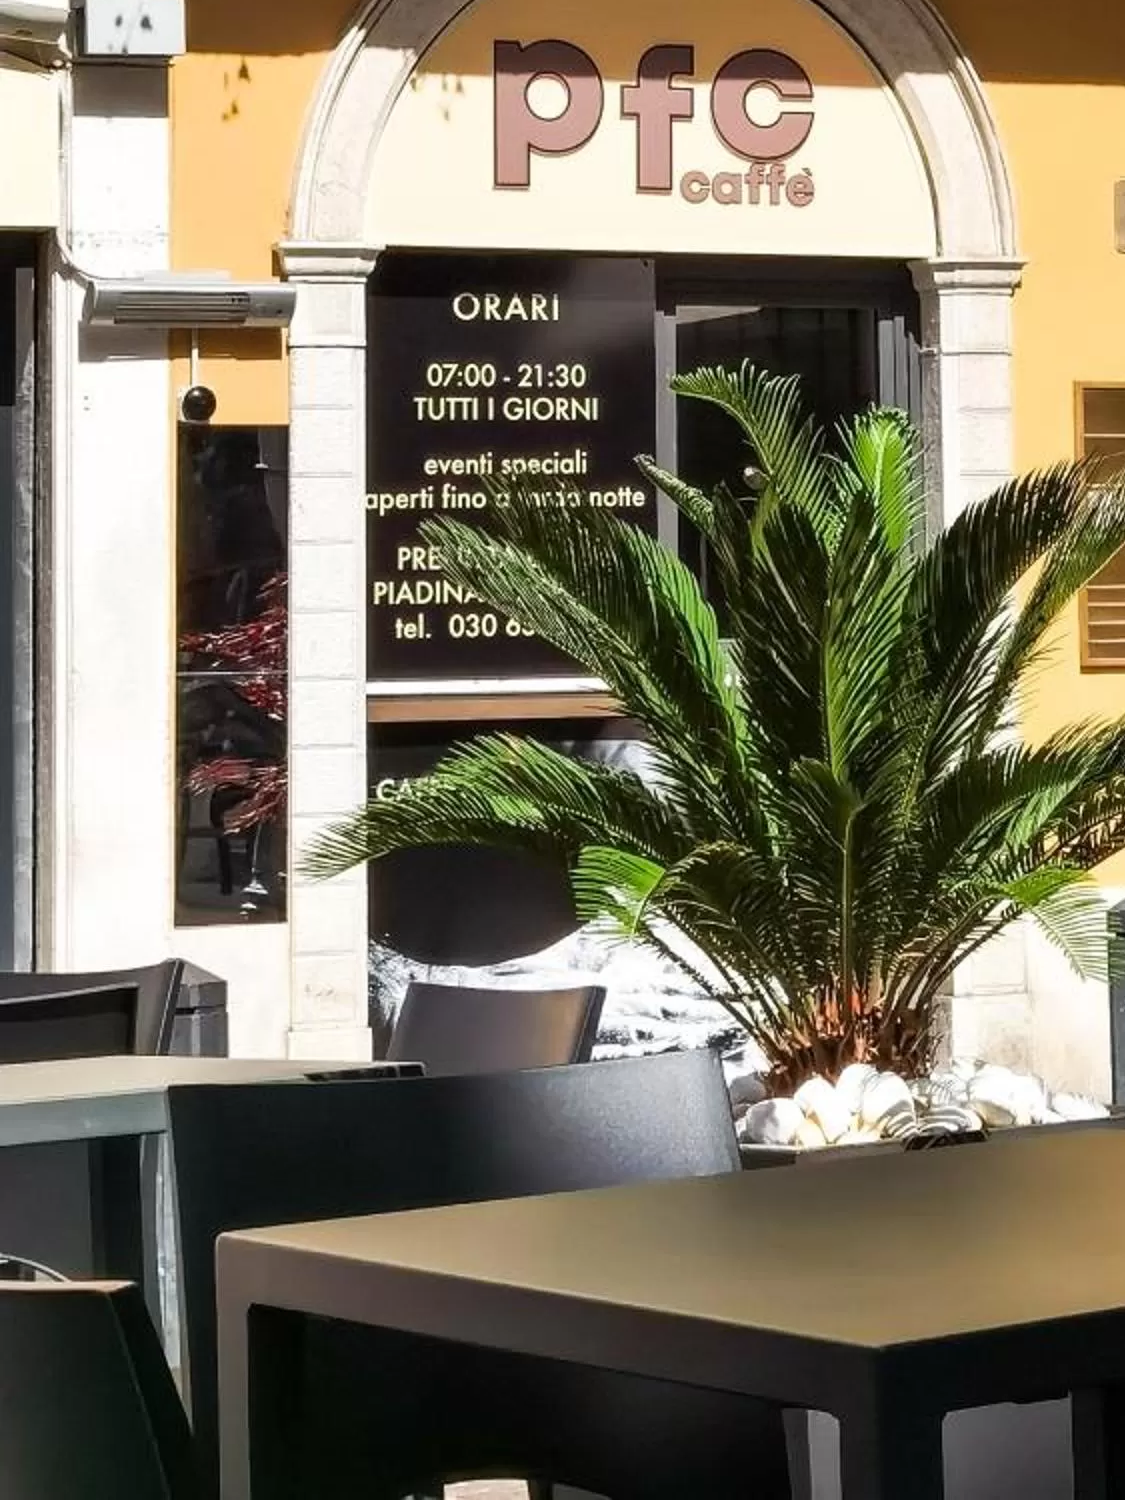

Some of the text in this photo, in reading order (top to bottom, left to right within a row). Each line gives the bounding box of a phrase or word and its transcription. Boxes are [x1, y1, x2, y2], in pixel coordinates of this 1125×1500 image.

[493, 38, 815, 192] pfc
[680, 162, 815, 207] caffè
[452, 293, 560, 321] ORARI
[426, 363, 497, 388] 07:00
[517, 363, 587, 388] 21:30
[413, 396, 599, 421] TUTTI I GIORNI
[423, 448, 588, 481] eventi speciali
[365, 484, 434, 516] aperti
[441, 482, 487, 509] fino
[589, 486, 646, 508] notte
[395, 612, 432, 639] tel.
[448, 613, 498, 638] 030
